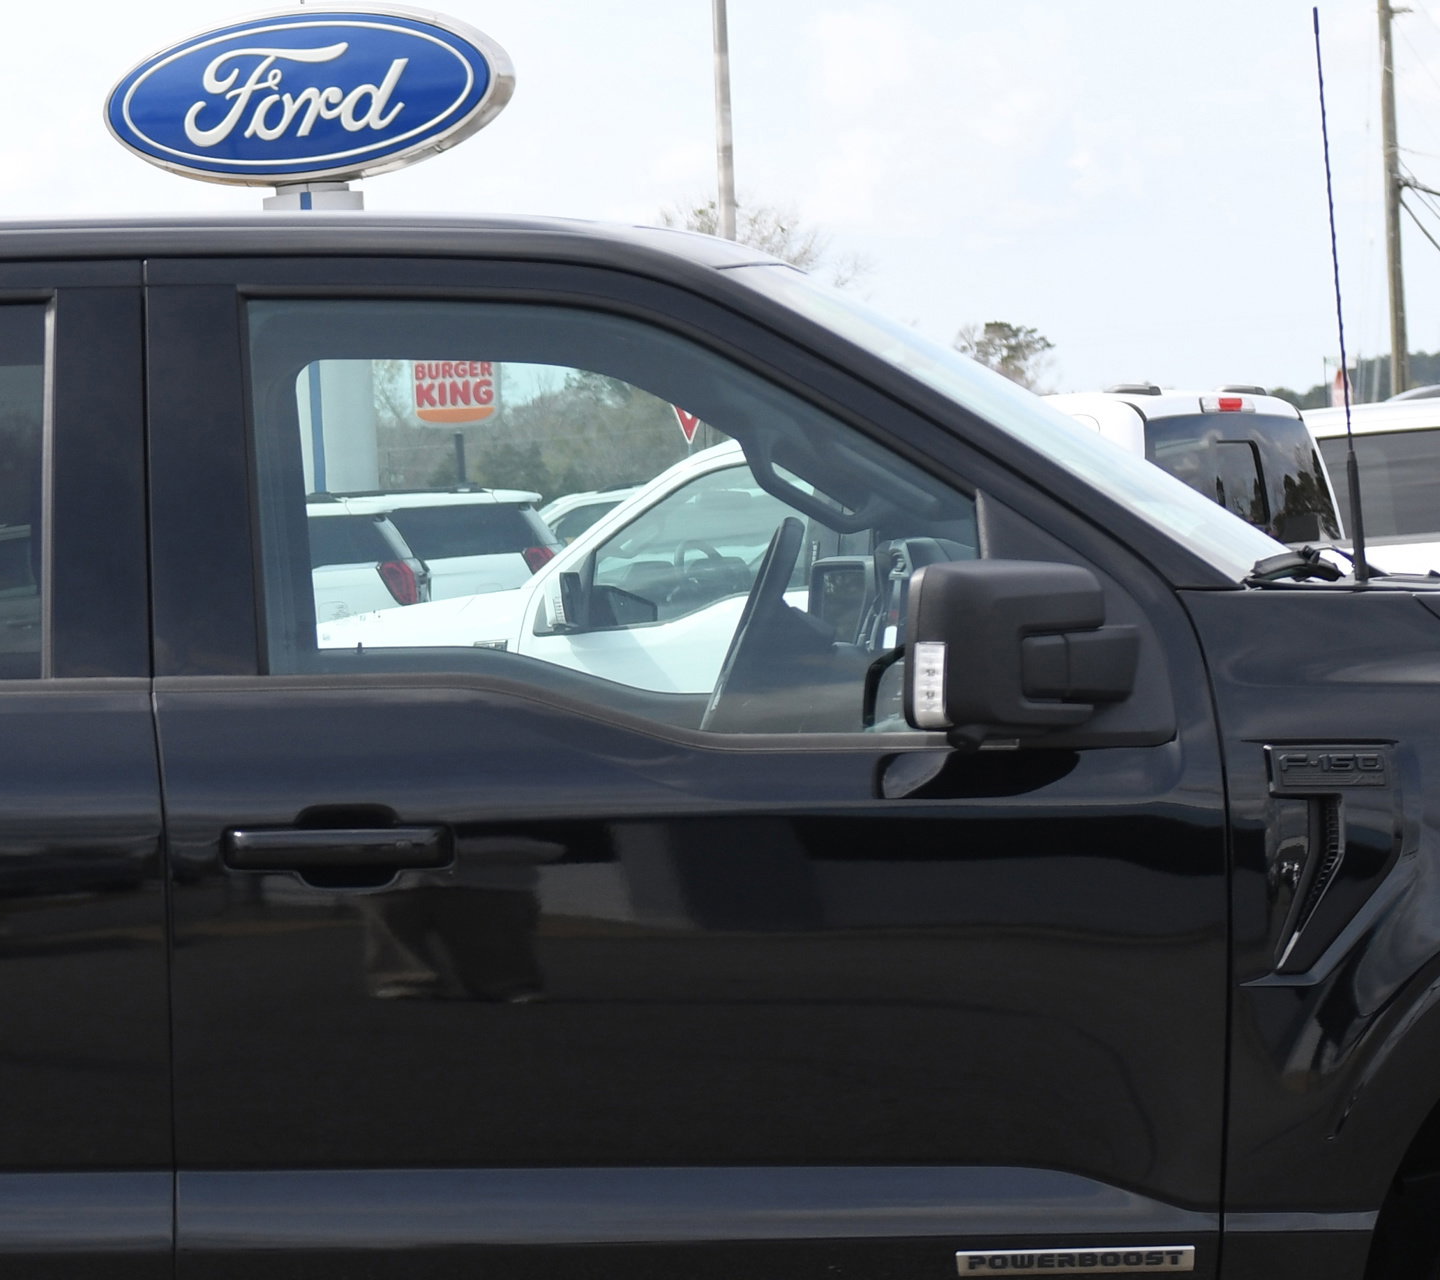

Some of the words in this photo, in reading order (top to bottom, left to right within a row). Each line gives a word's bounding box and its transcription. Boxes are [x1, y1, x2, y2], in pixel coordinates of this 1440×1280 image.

[184, 41, 409, 147] Ford
[414, 360, 493, 381] BURGER
[416, 379, 494, 408] KING
[1277, 753, 1385, 772] F-150
[967, 1250, 1184, 1270] POWERBOOST
